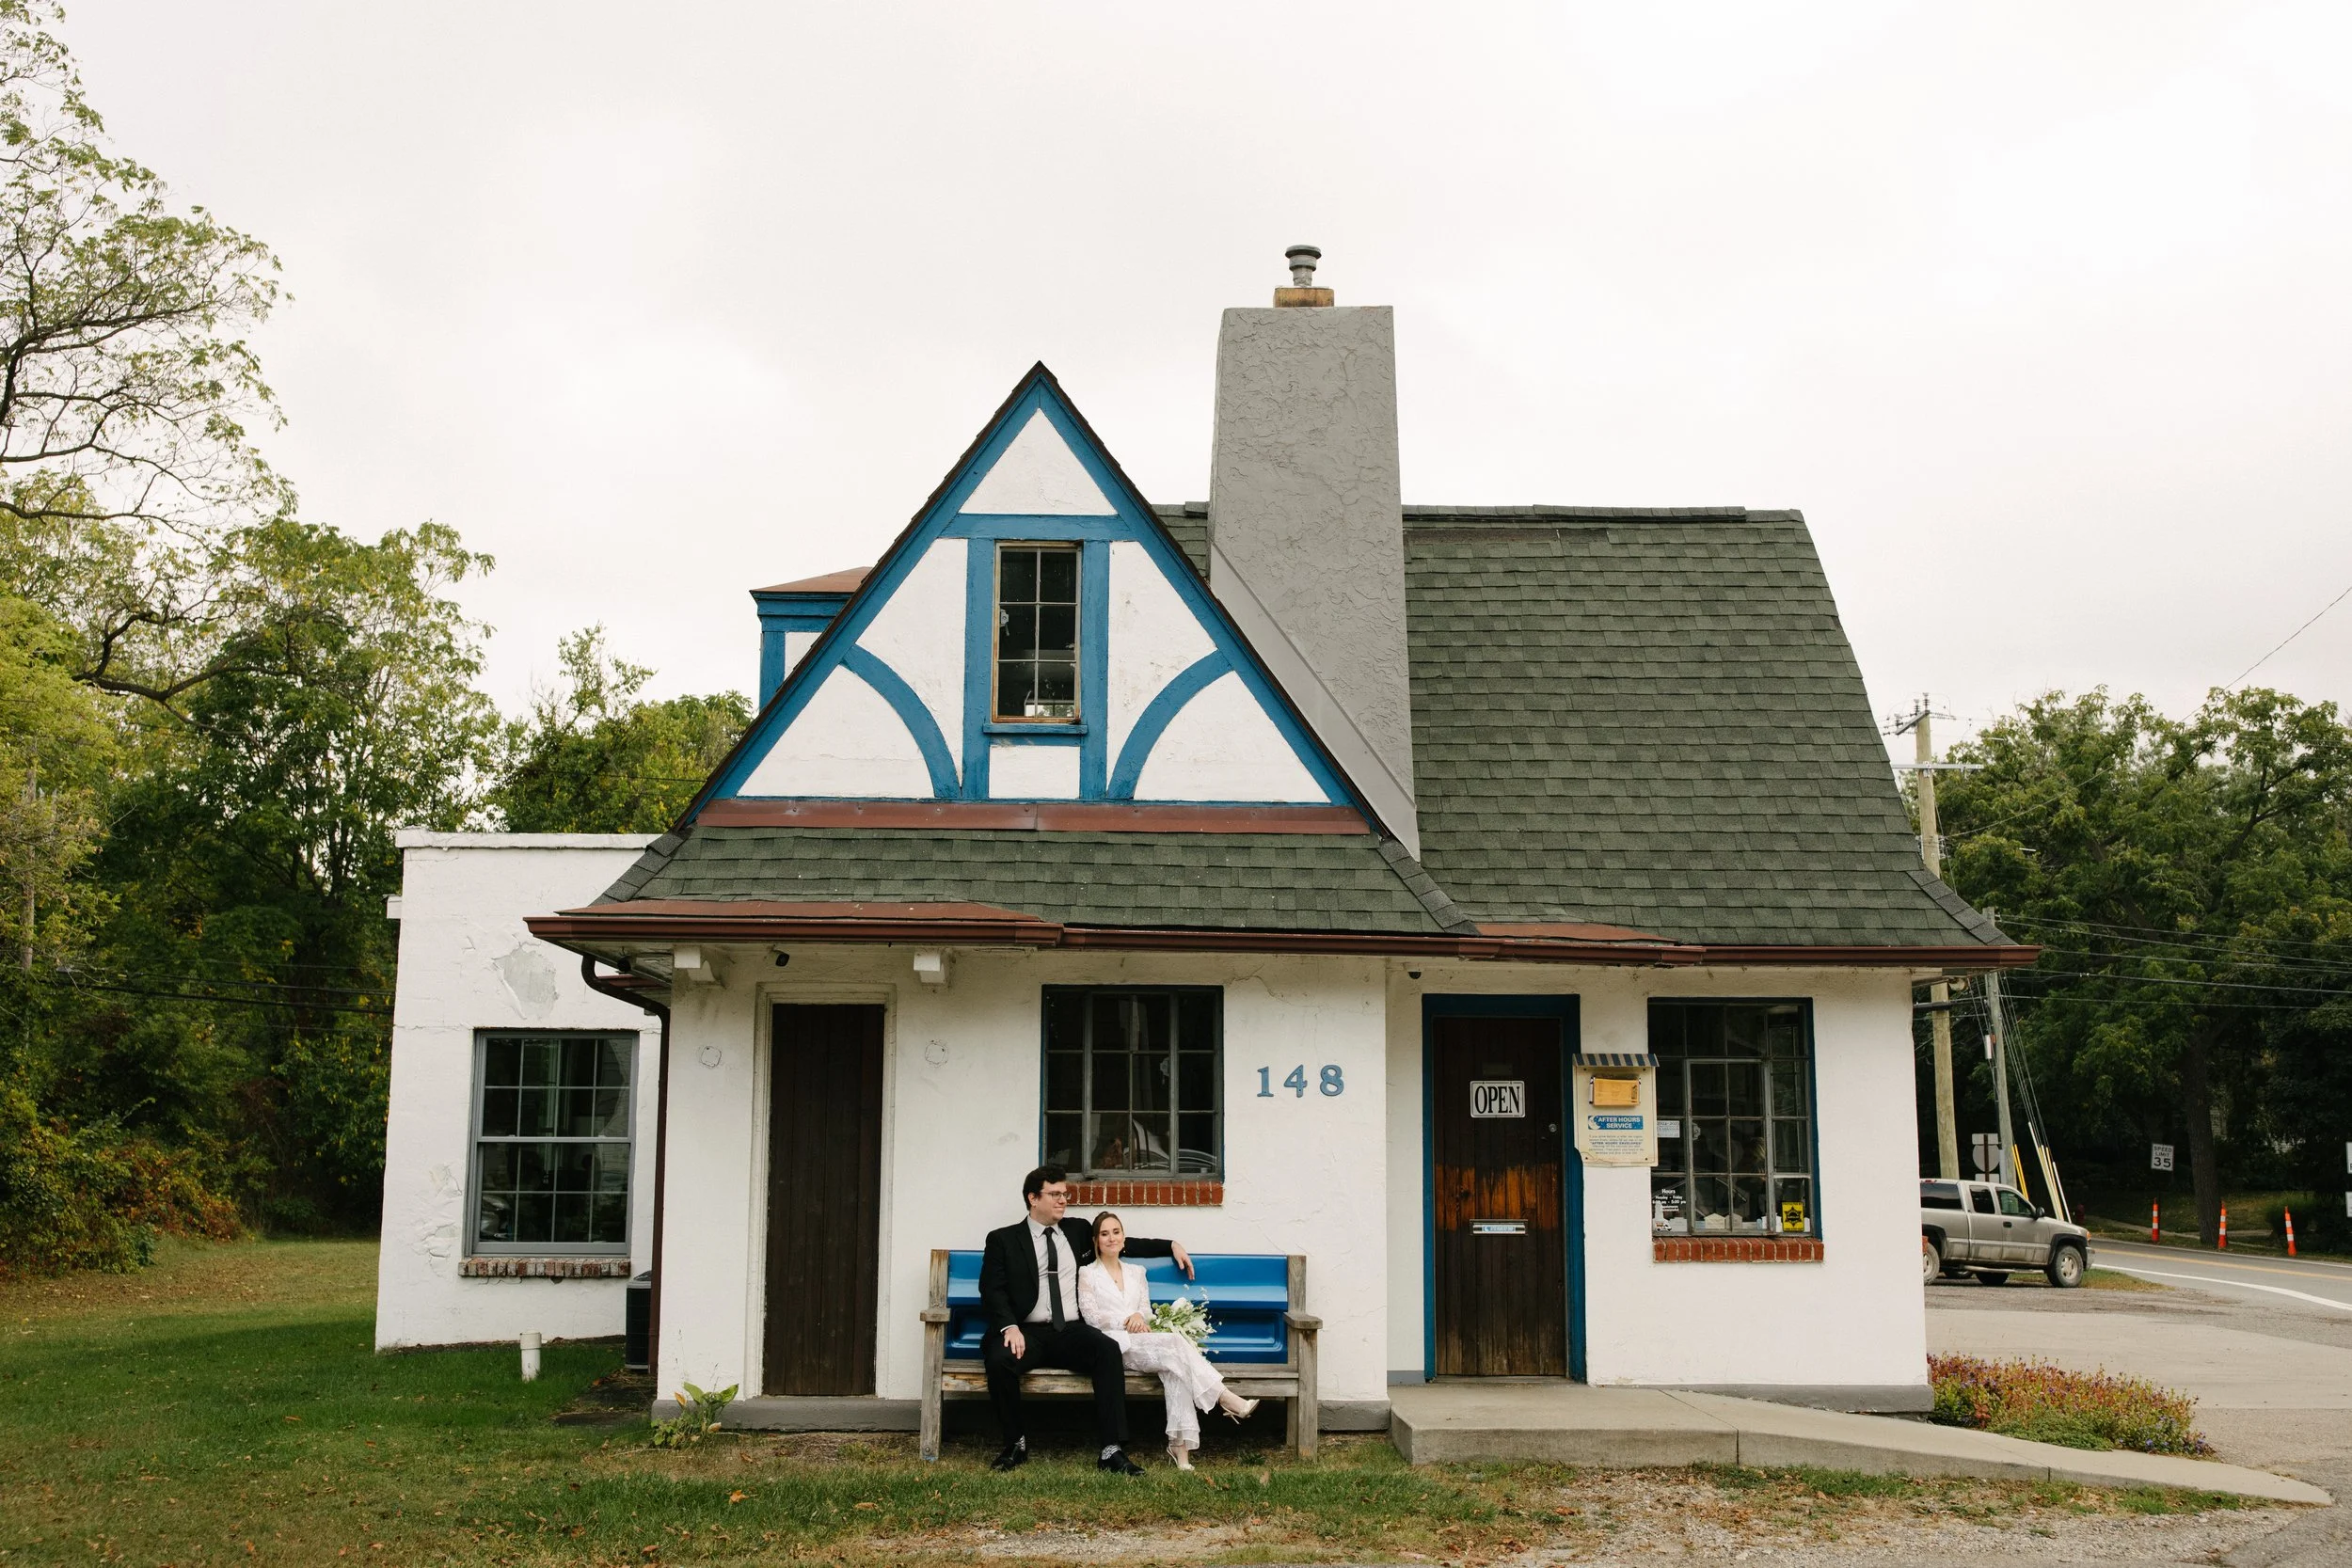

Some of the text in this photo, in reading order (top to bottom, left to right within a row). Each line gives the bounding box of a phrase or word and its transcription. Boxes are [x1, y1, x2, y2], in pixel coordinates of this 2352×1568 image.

[1257, 1064, 1344, 1098] 148
[1475, 1085, 1520, 1114] OPEN
[2153, 1157, 2171, 1167] 35
